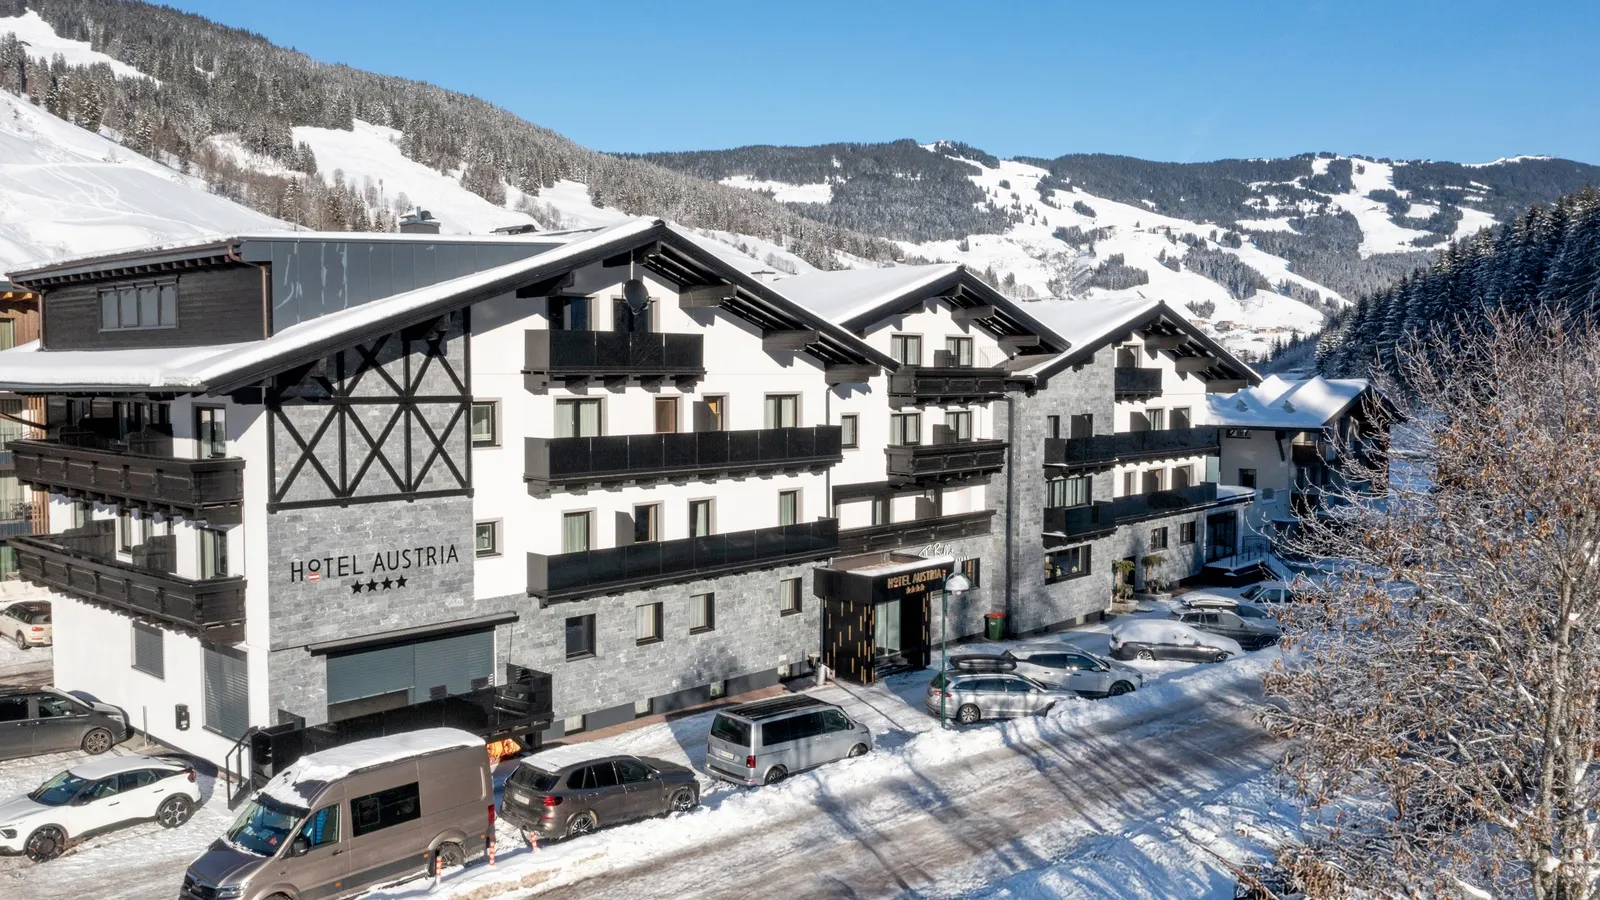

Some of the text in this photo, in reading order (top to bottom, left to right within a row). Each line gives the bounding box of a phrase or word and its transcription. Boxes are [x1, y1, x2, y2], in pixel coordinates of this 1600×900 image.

[291, 544, 459, 582] HOTEL AUSTRIA
[912, 568, 942, 583] AUSTRIA
